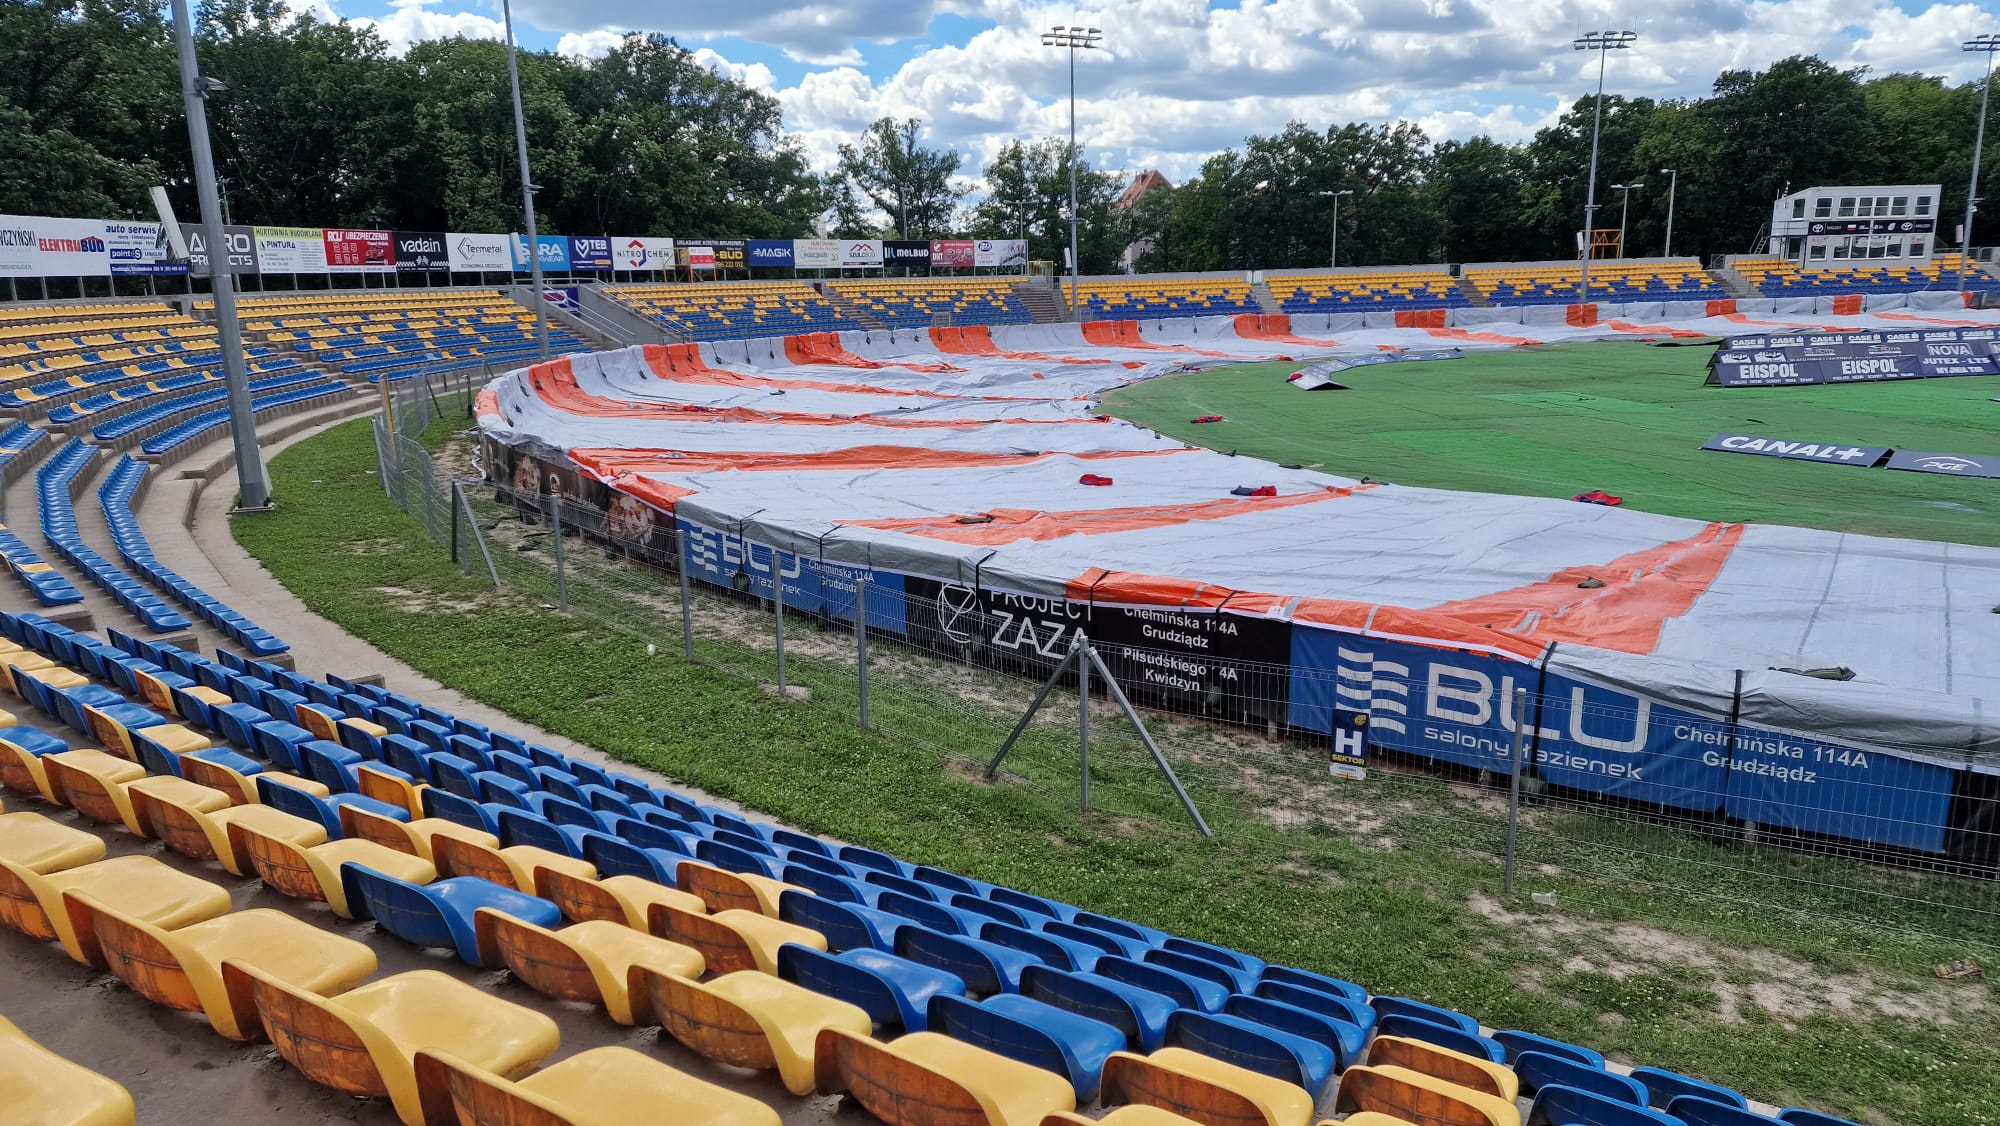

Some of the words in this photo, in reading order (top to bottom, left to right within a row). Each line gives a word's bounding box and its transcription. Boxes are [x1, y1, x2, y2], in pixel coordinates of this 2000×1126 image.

[0, 227, 36, 246] CZYŃSKI
[105, 224, 126, 233] auto
[128, 225, 157, 234] serwis
[190, 232, 250, 253] ARO
[266, 241, 296, 249] PINTURA
[400, 237, 441, 252] vadain
[465, 244, 502, 253] Termetal
[520, 243, 564, 256] SRA
[589, 239, 607, 250] TEB
[647, 249, 669, 257] CHEM
[1929, 345, 1971, 356] NOVA
[1841, 358, 1899, 375] EKSPOL
[1922, 357, 1960, 365] JUTEX
[1740, 363, 1799, 379] EKSPOL
[1721, 436, 1865, 460] CANAL+
[1922, 461, 1968, 471] PGE
[1142, 624, 1209, 649] Grudziądz
[1123, 647, 1207, 676] Piłsudskiego
[1145, 668, 1200, 692] Kwidzyn
[1426, 662, 1651, 753] BLU
[1335, 727, 1363, 756] H
[1674, 725, 1804, 760] Chełmińska
[1814, 746, 1869, 769] 114A
[1331, 753, 1365, 766] SEKTOR
[1425, 727, 1509, 757] salony
[1522, 744, 1644, 781] łazienek
[1703, 750, 1817, 783] Grudziądz
